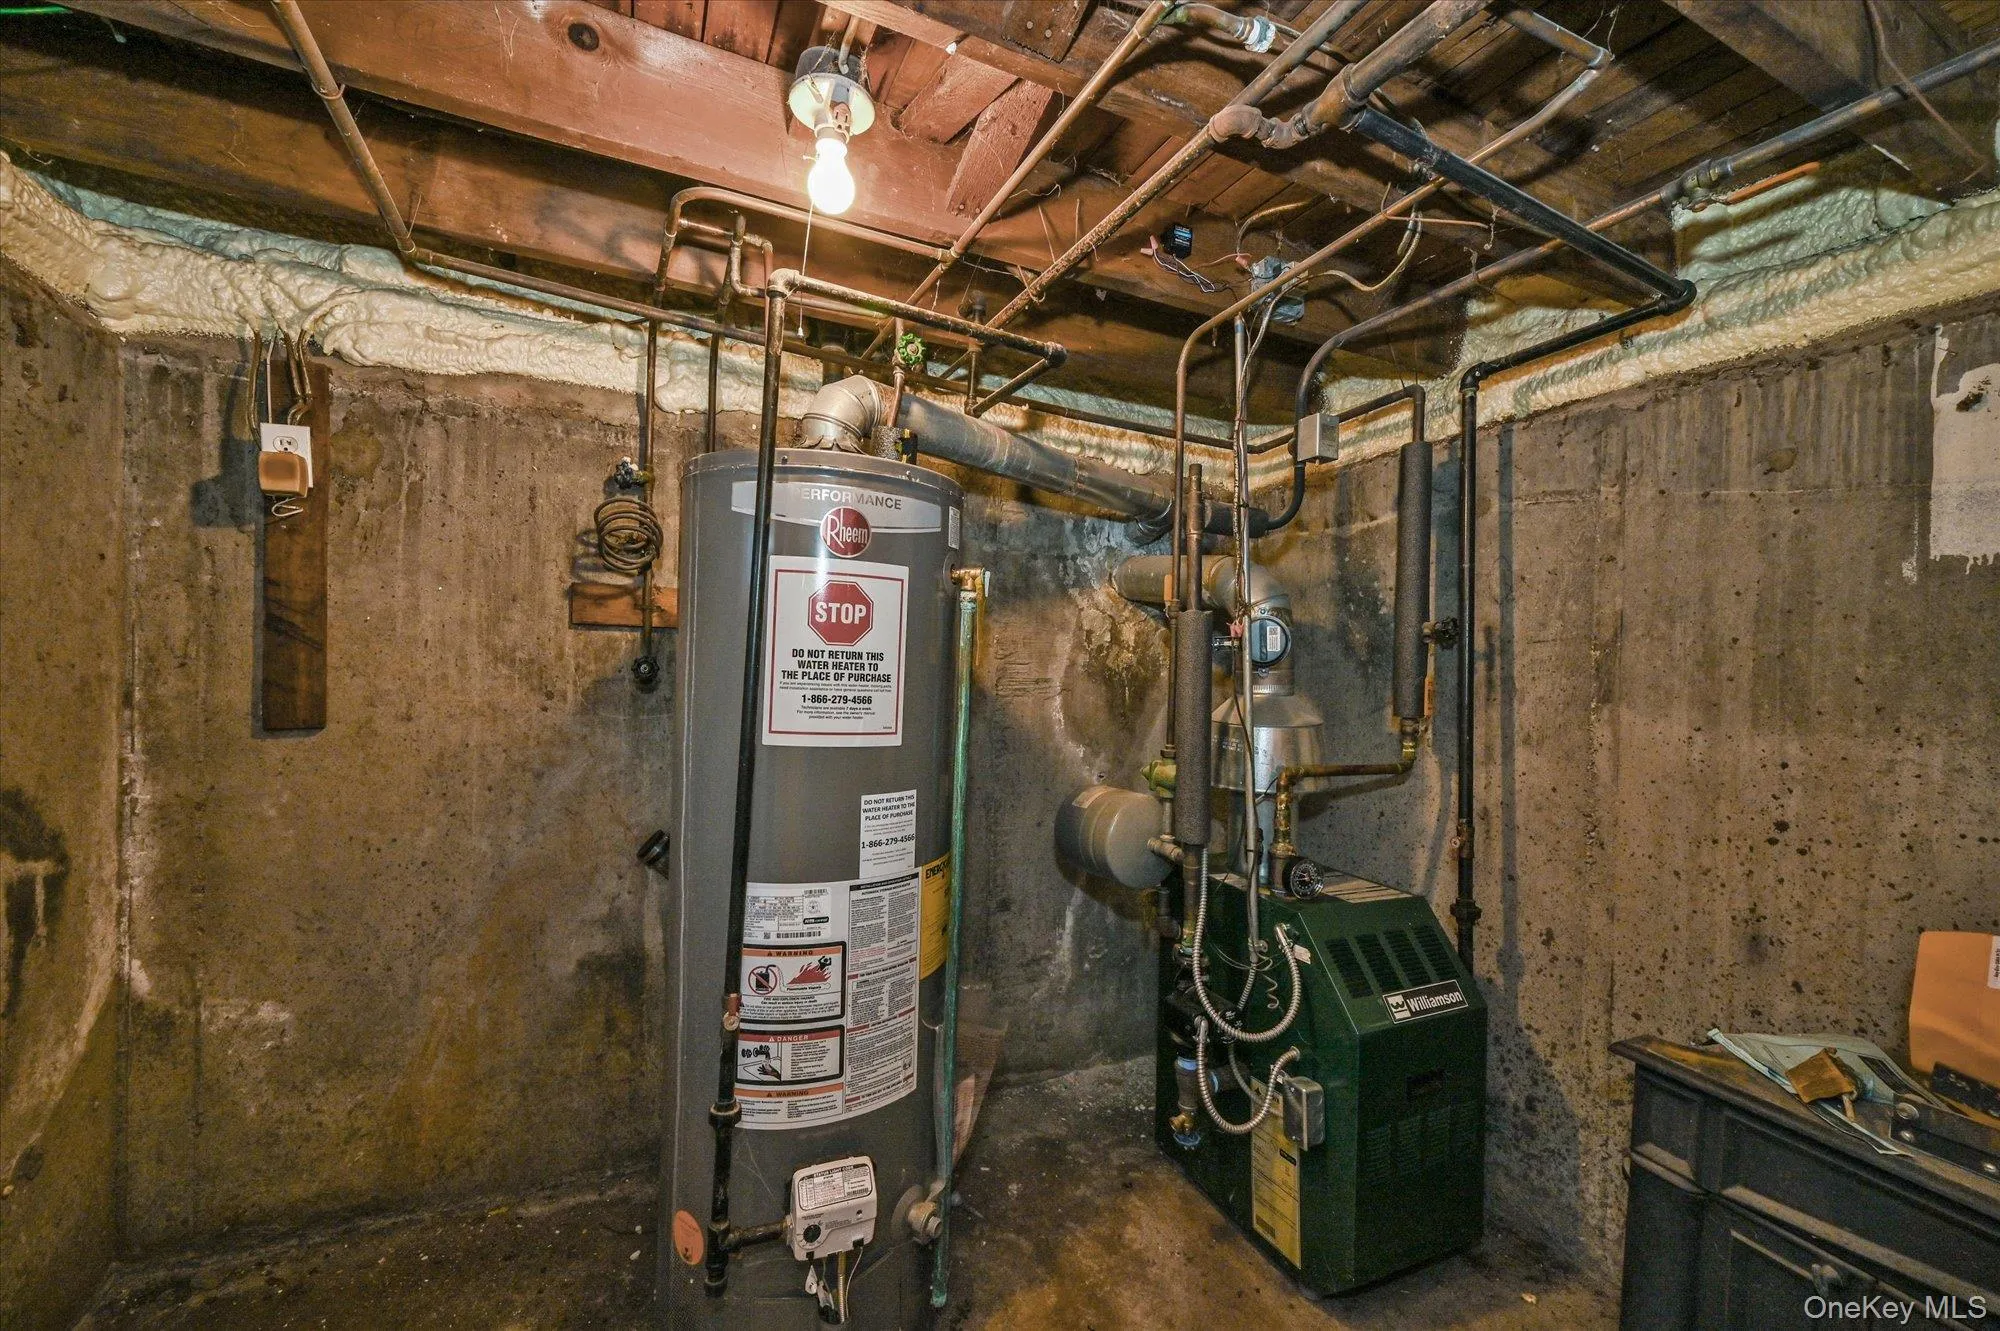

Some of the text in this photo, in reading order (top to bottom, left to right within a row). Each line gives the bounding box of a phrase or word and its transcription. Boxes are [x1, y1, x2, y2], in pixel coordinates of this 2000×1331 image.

[827, 508, 868, 548] Rheem
[815, 602, 866, 624] STOP
[792, 649, 884, 661] DO NOT RETURN THIS
[798, 660, 878, 671] WATER HEATER TO
[782, 670, 891, 682] THE PLACE OF PURCHASE
[802, 695, 872, 704] 1-866-279-4566
[890, 810, 913, 818] PURCHASE
[1407, 992, 1462, 1012] Williamson
